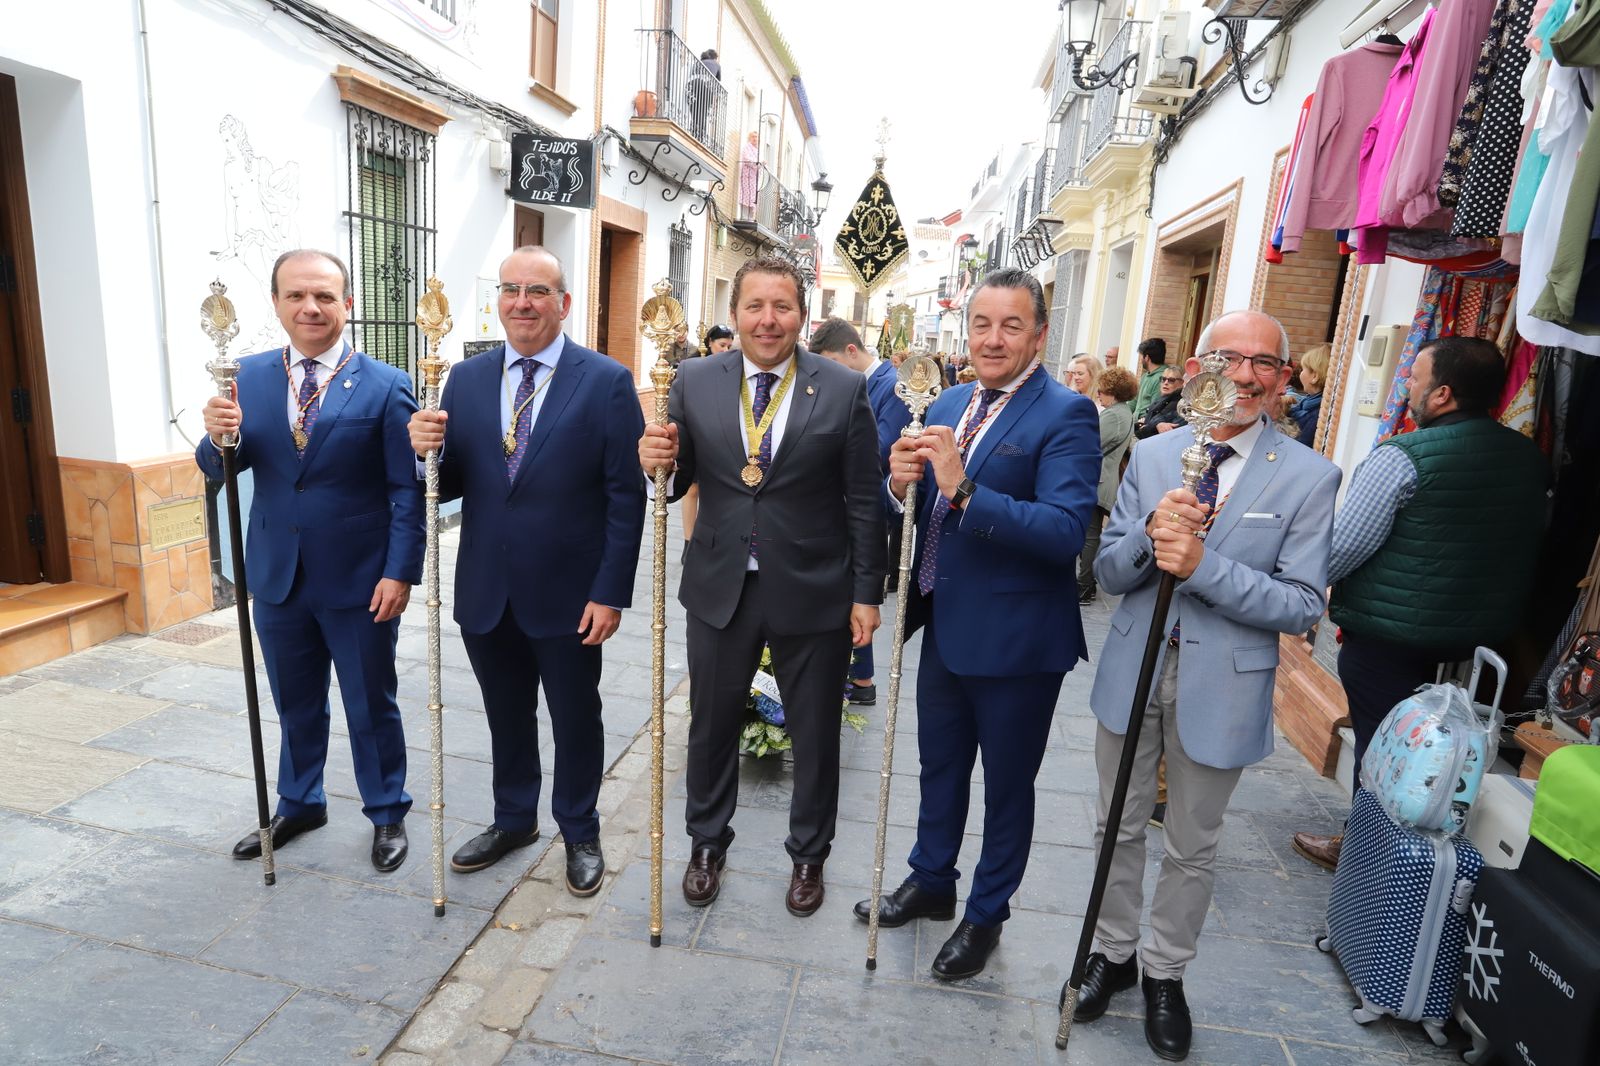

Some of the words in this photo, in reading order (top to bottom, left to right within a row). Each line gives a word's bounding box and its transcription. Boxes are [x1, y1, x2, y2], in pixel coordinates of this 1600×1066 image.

[531, 190, 557, 202] ILDE
[560, 192, 573, 203] II
[1115, 271, 1126, 280] 42
[1529, 950, 1575, 1000] THERMO
